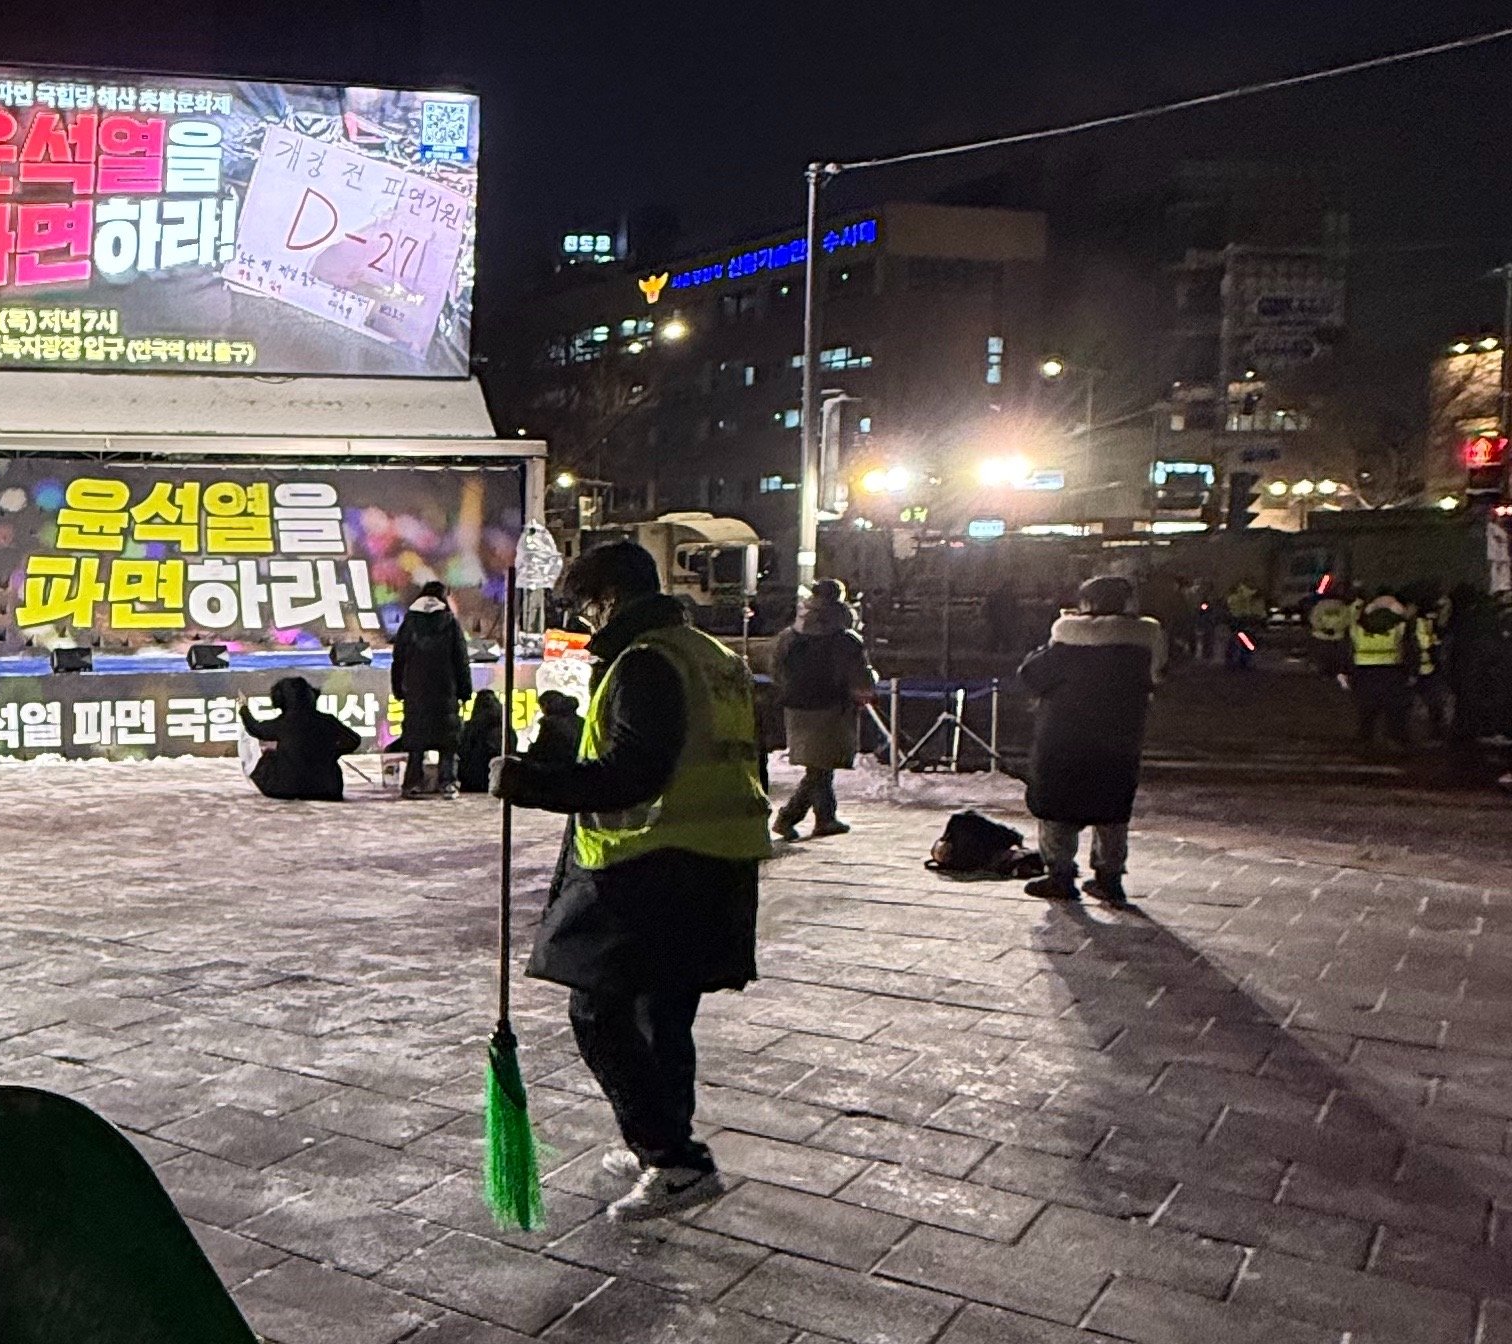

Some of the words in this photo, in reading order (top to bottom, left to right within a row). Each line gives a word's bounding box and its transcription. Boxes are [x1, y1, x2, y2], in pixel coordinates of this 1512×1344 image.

[285, 186, 419, 278] D-27
[84, 335, 125, 362] 입구
[54, 476, 347, 554] 윤석열을
[14, 555, 381, 631] 파면하라!
[72, 699, 156, 747] 파면
